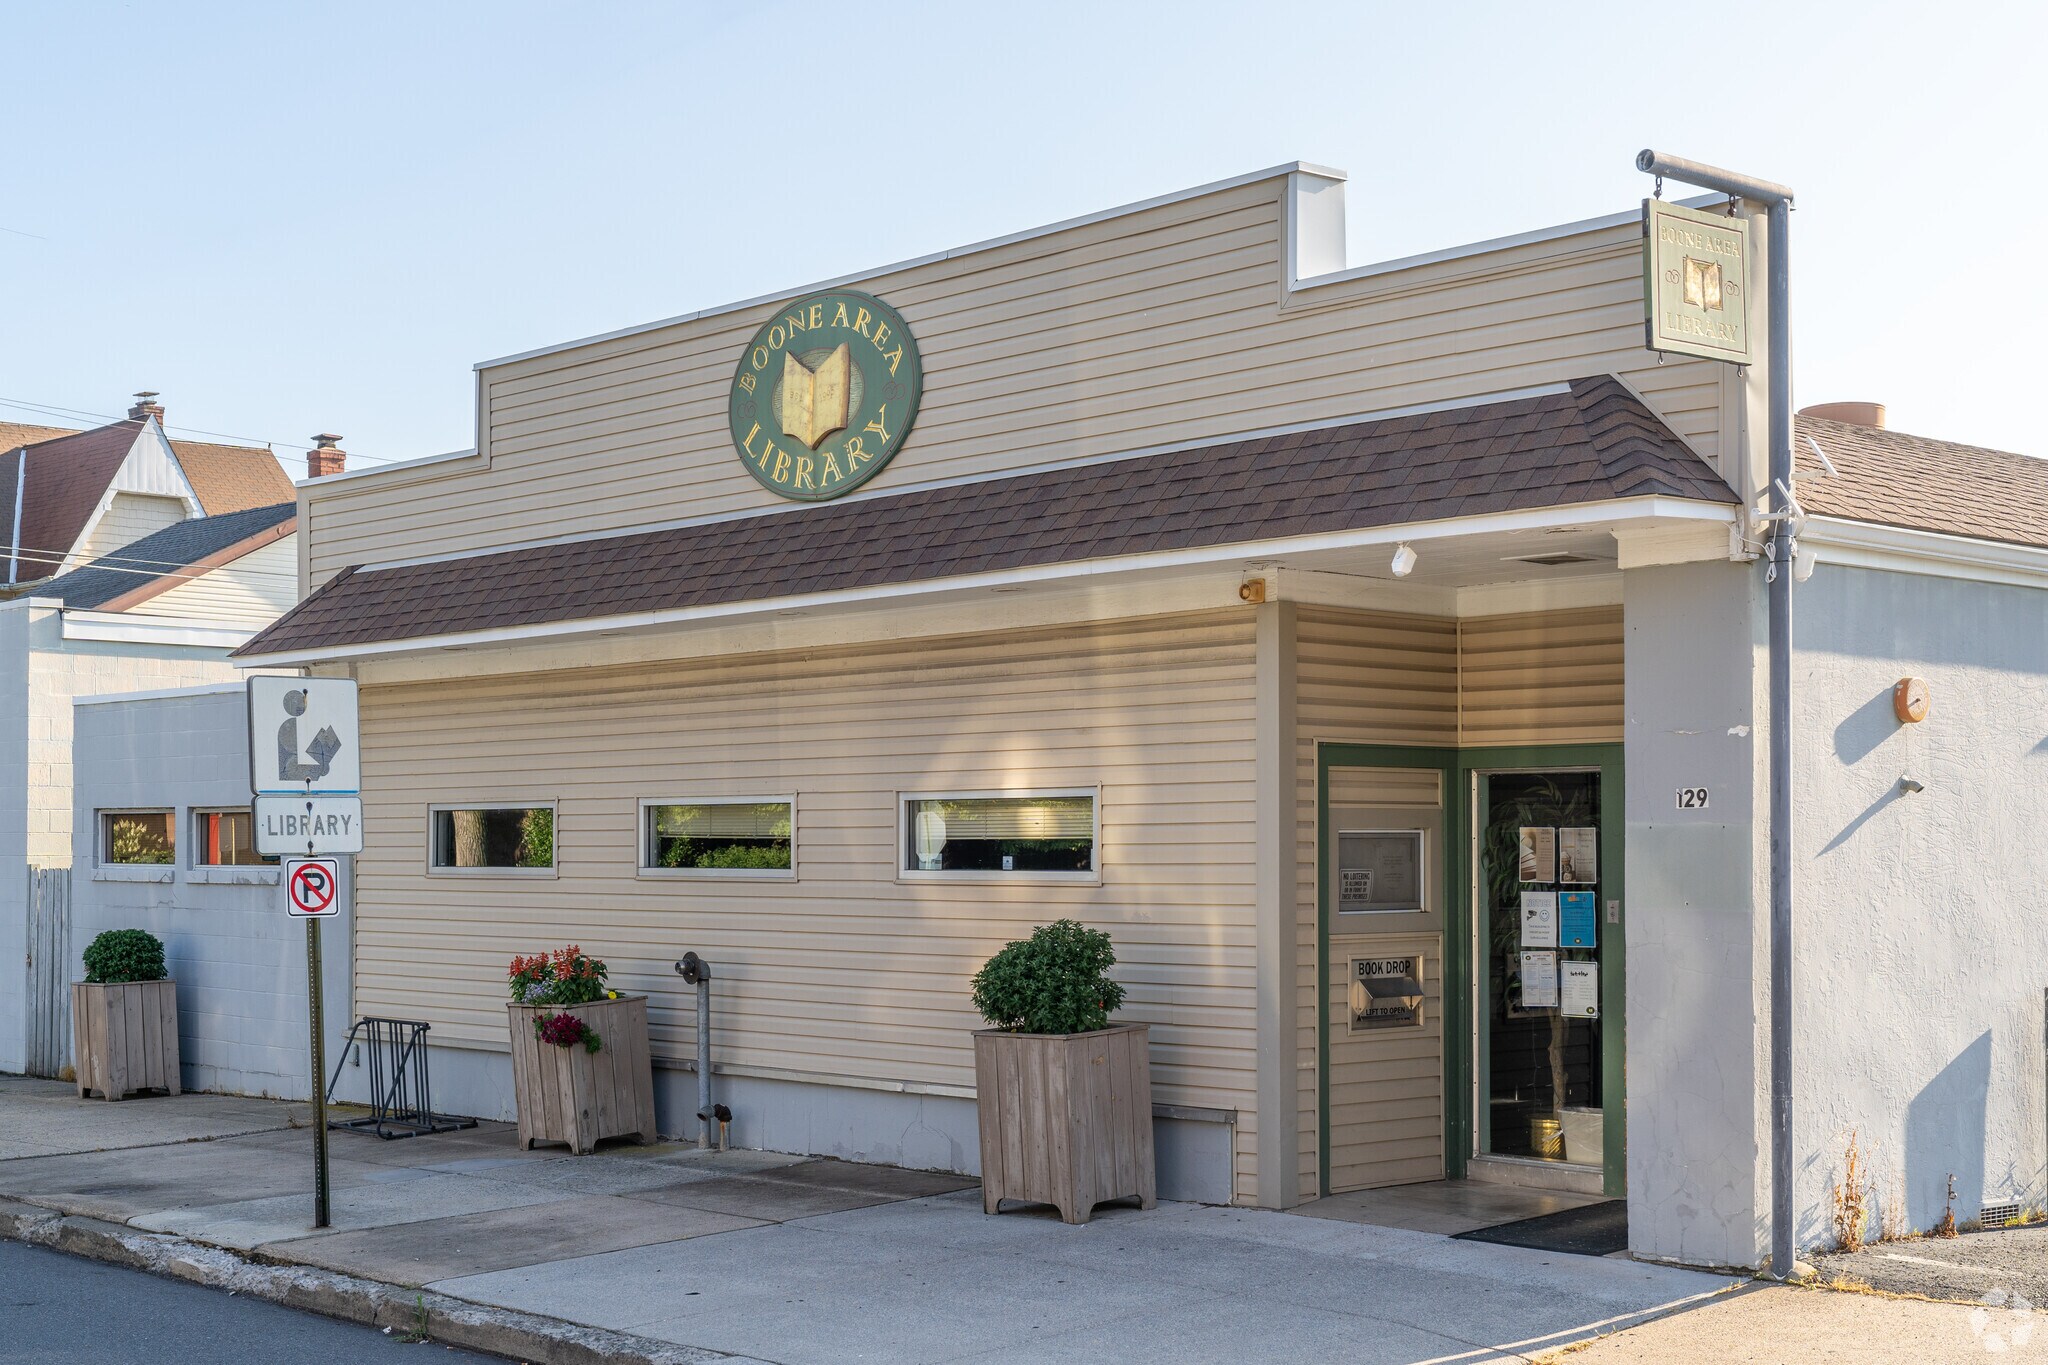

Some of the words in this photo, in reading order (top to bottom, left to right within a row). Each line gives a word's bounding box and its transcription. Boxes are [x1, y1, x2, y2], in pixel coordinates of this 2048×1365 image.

[1660, 225, 1703, 250] BOONE
[1705, 236, 1740, 258] AREA
[1665, 311, 1738, 342] LIBRARY
[738, 303, 823, 396] BOONE
[831, 302, 903, 377] AREA
[742, 403, 891, 490] LIBRARY
[1676, 788, 1708, 808] 129
[267, 814, 352, 836] LIBRARY
[1359, 962, 1383, 975] BOOK
[1387, 960, 1411, 974] DROP
[1380, 1007, 1388, 1015] TO
